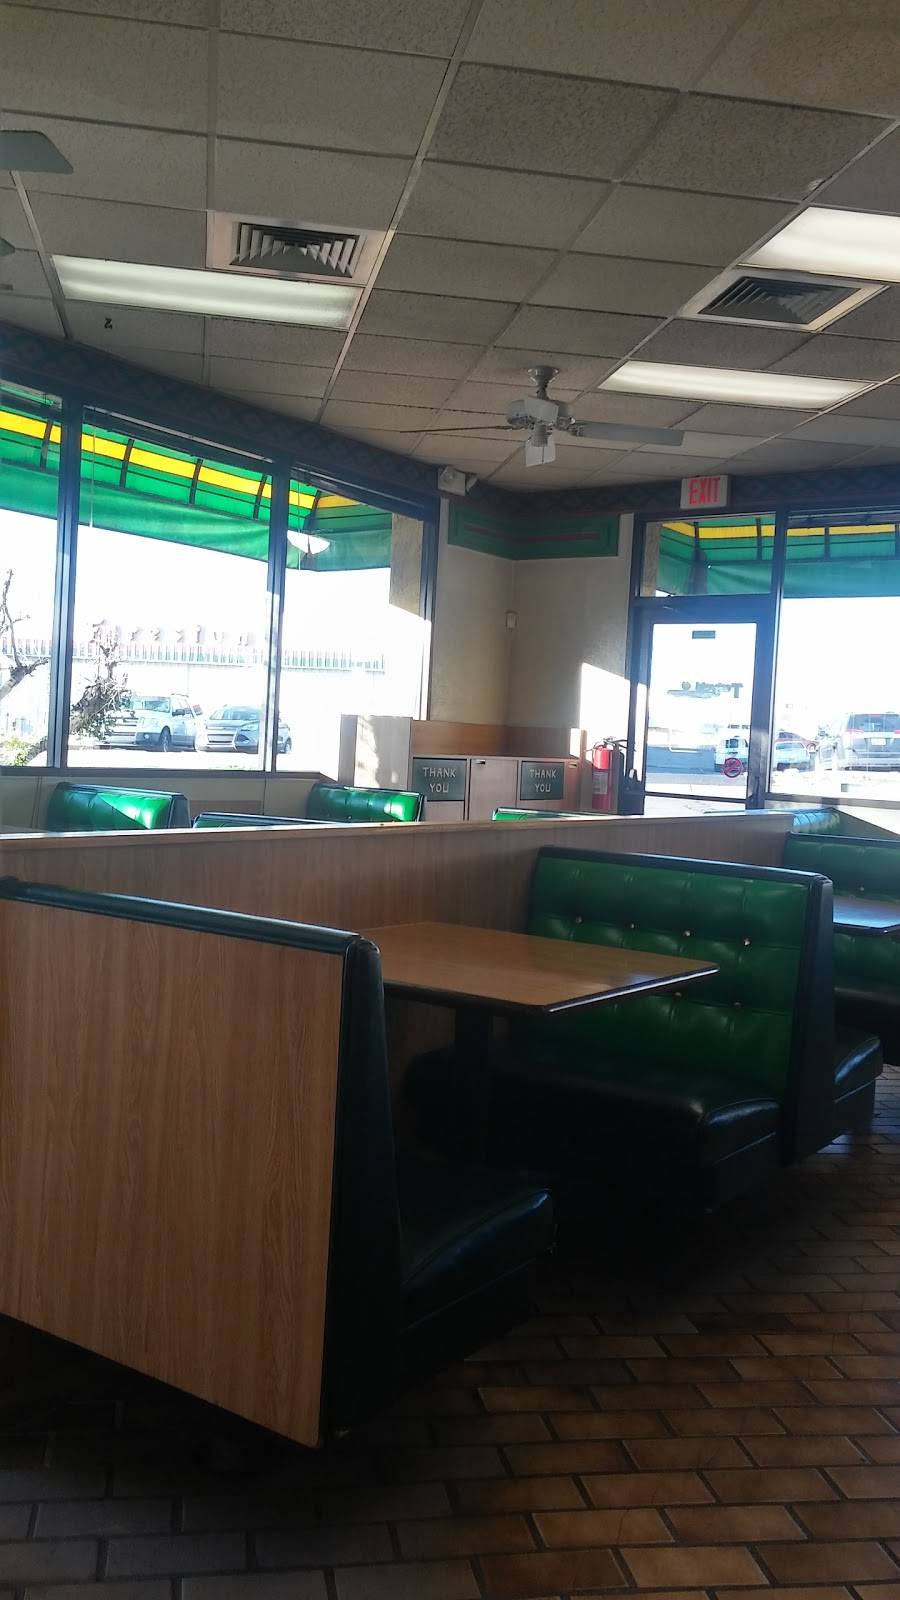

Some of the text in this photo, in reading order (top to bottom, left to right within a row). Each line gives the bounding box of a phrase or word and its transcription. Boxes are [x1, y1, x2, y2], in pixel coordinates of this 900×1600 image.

[688, 475, 720, 504] EXIT
[423, 766, 457, 778] THANK
[529, 769, 557, 779] THANK
[429, 783, 449, 793] YOU
[534, 783, 551, 793] YOU
